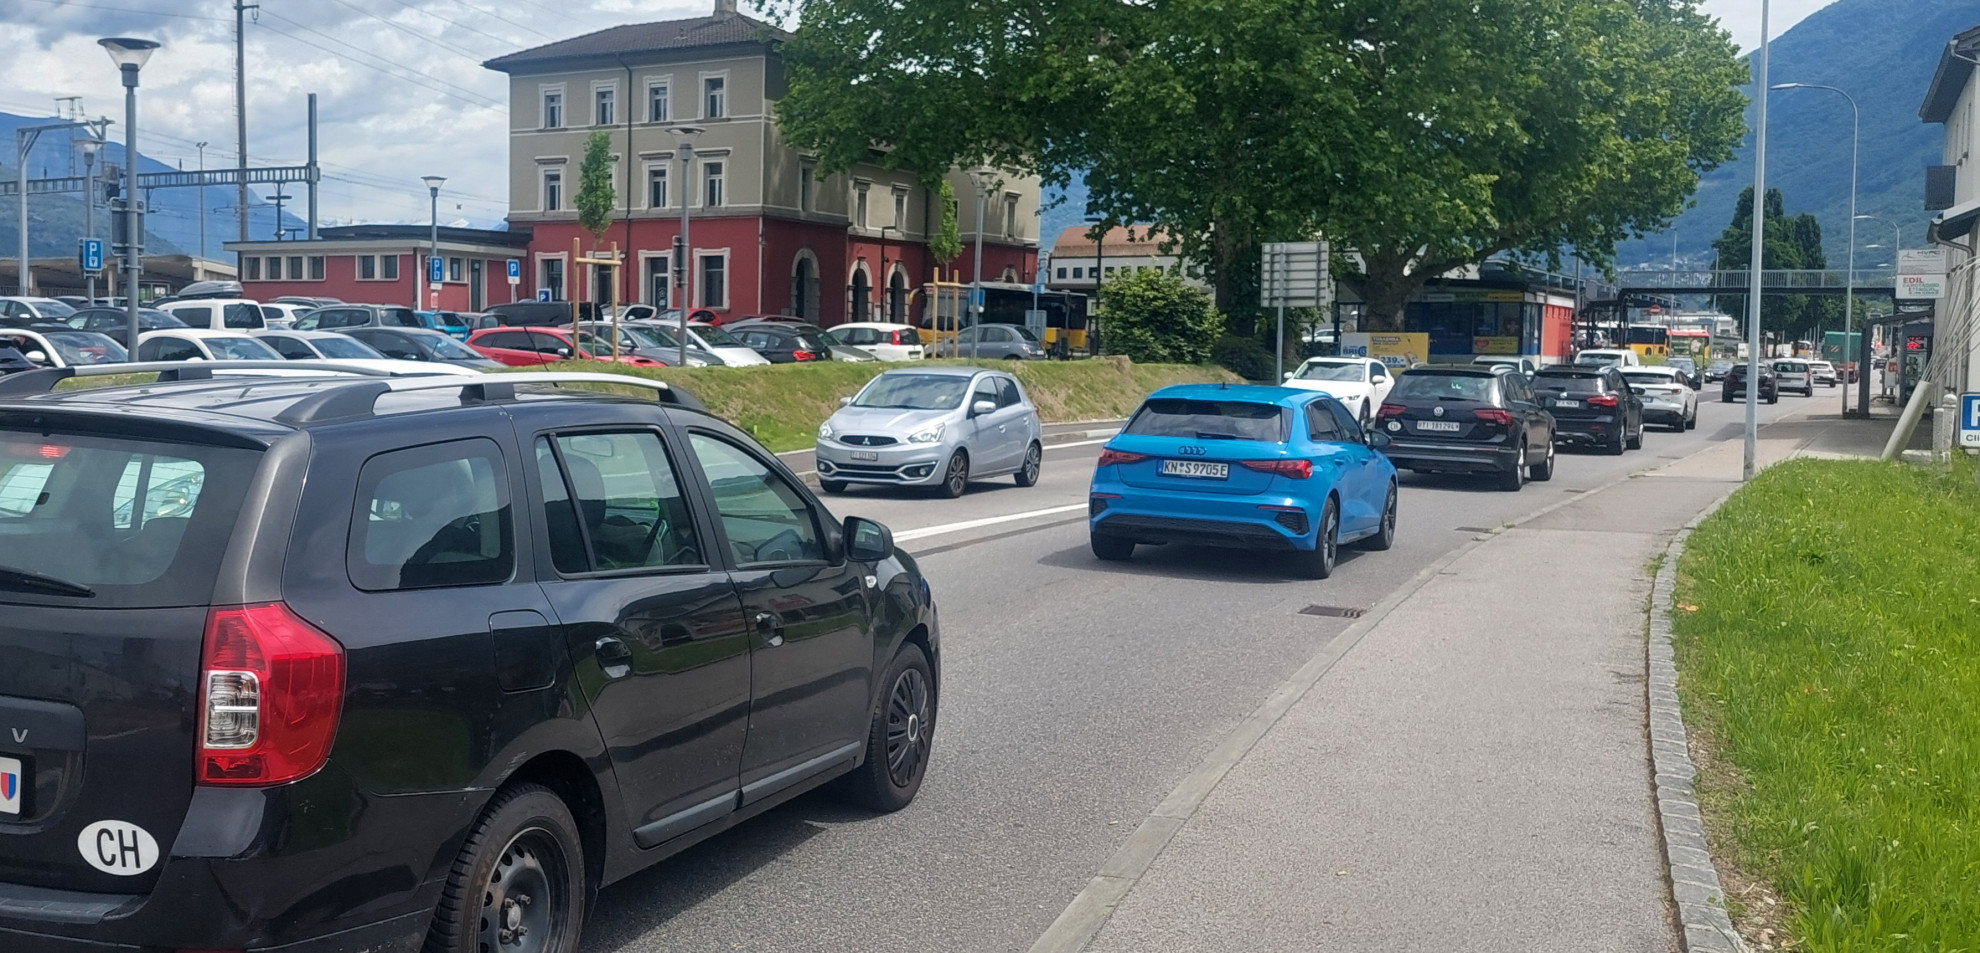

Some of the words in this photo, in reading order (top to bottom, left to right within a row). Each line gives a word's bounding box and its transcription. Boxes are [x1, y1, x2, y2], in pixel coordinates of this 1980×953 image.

[89, 242, 98, 256] P
[510, 263, 517, 276] P
[540, 294, 546, 302] P
[1164, 461, 1178, 473] KN
[1185, 463, 1192, 474] S
[96, 827, 141, 869] CH
